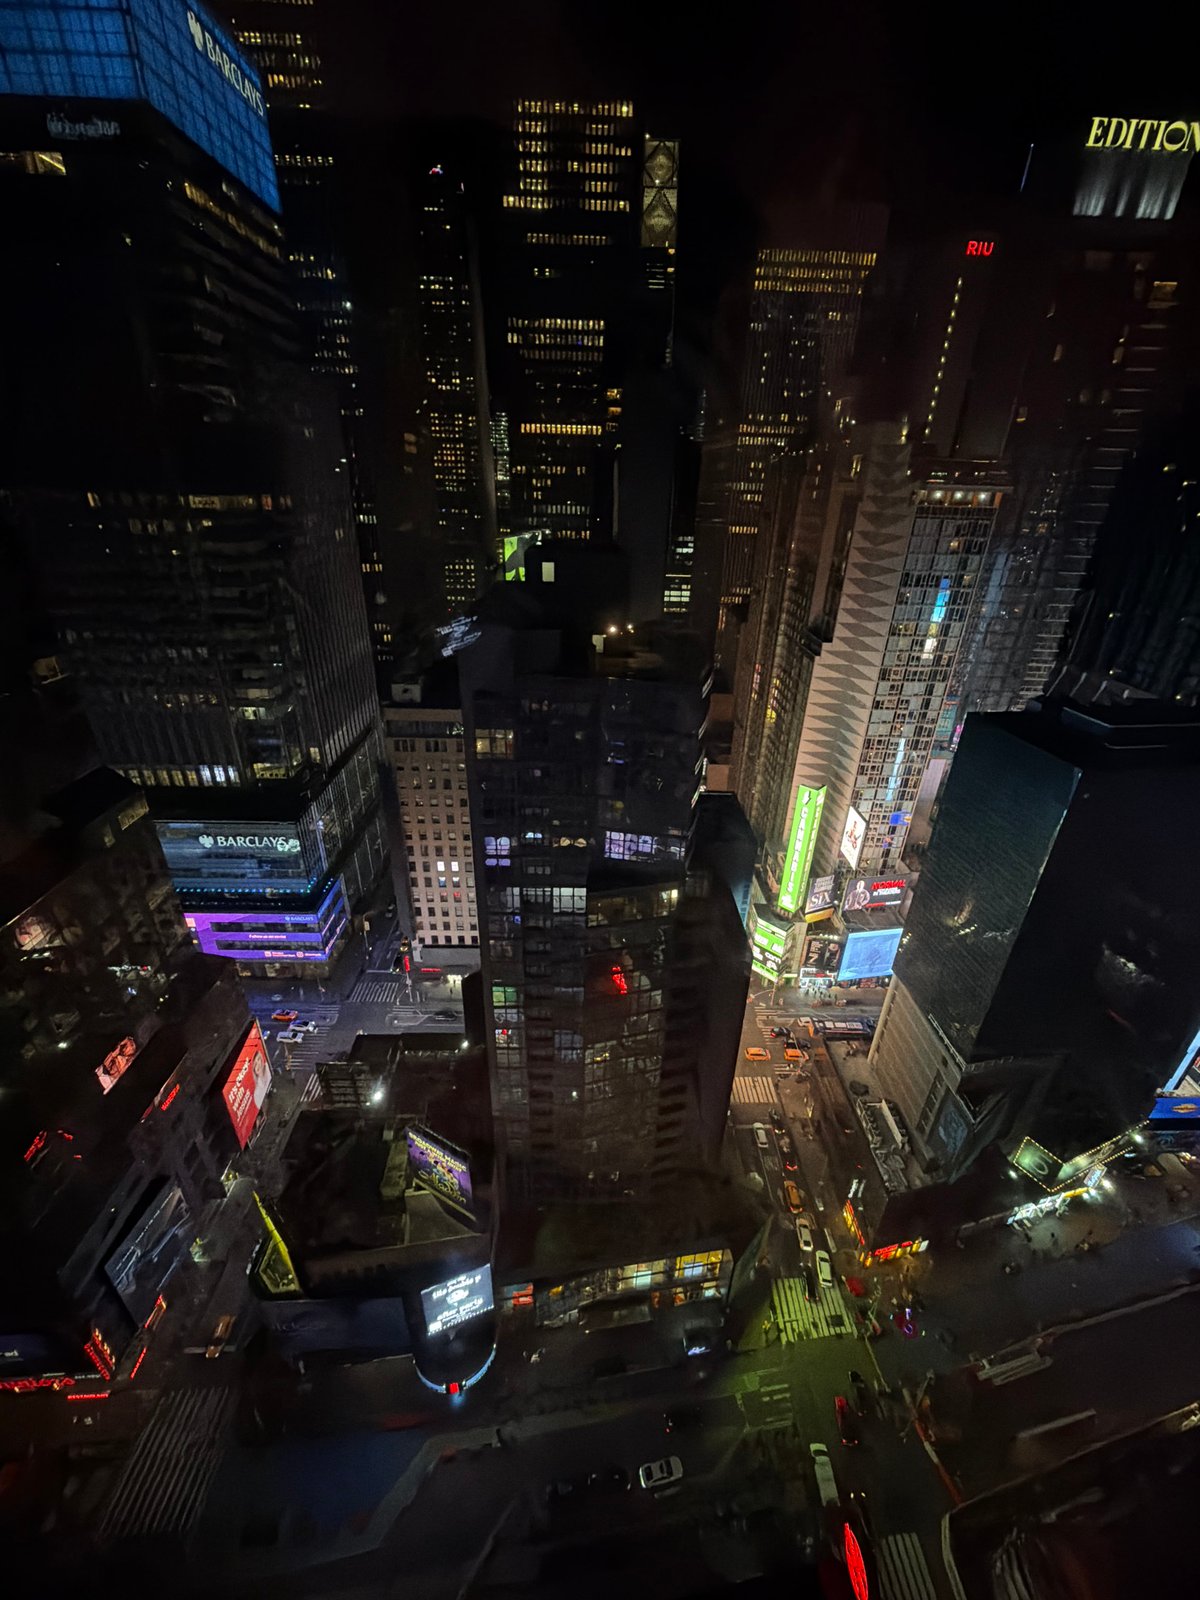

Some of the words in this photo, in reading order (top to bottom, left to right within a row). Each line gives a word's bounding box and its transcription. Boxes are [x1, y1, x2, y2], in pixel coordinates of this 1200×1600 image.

[205, 31, 263, 116] BARCLAYS
[966, 241, 994, 256] RIU
[217, 836, 286, 848] BARCLAYS
[811, 892, 831, 907] SIX
